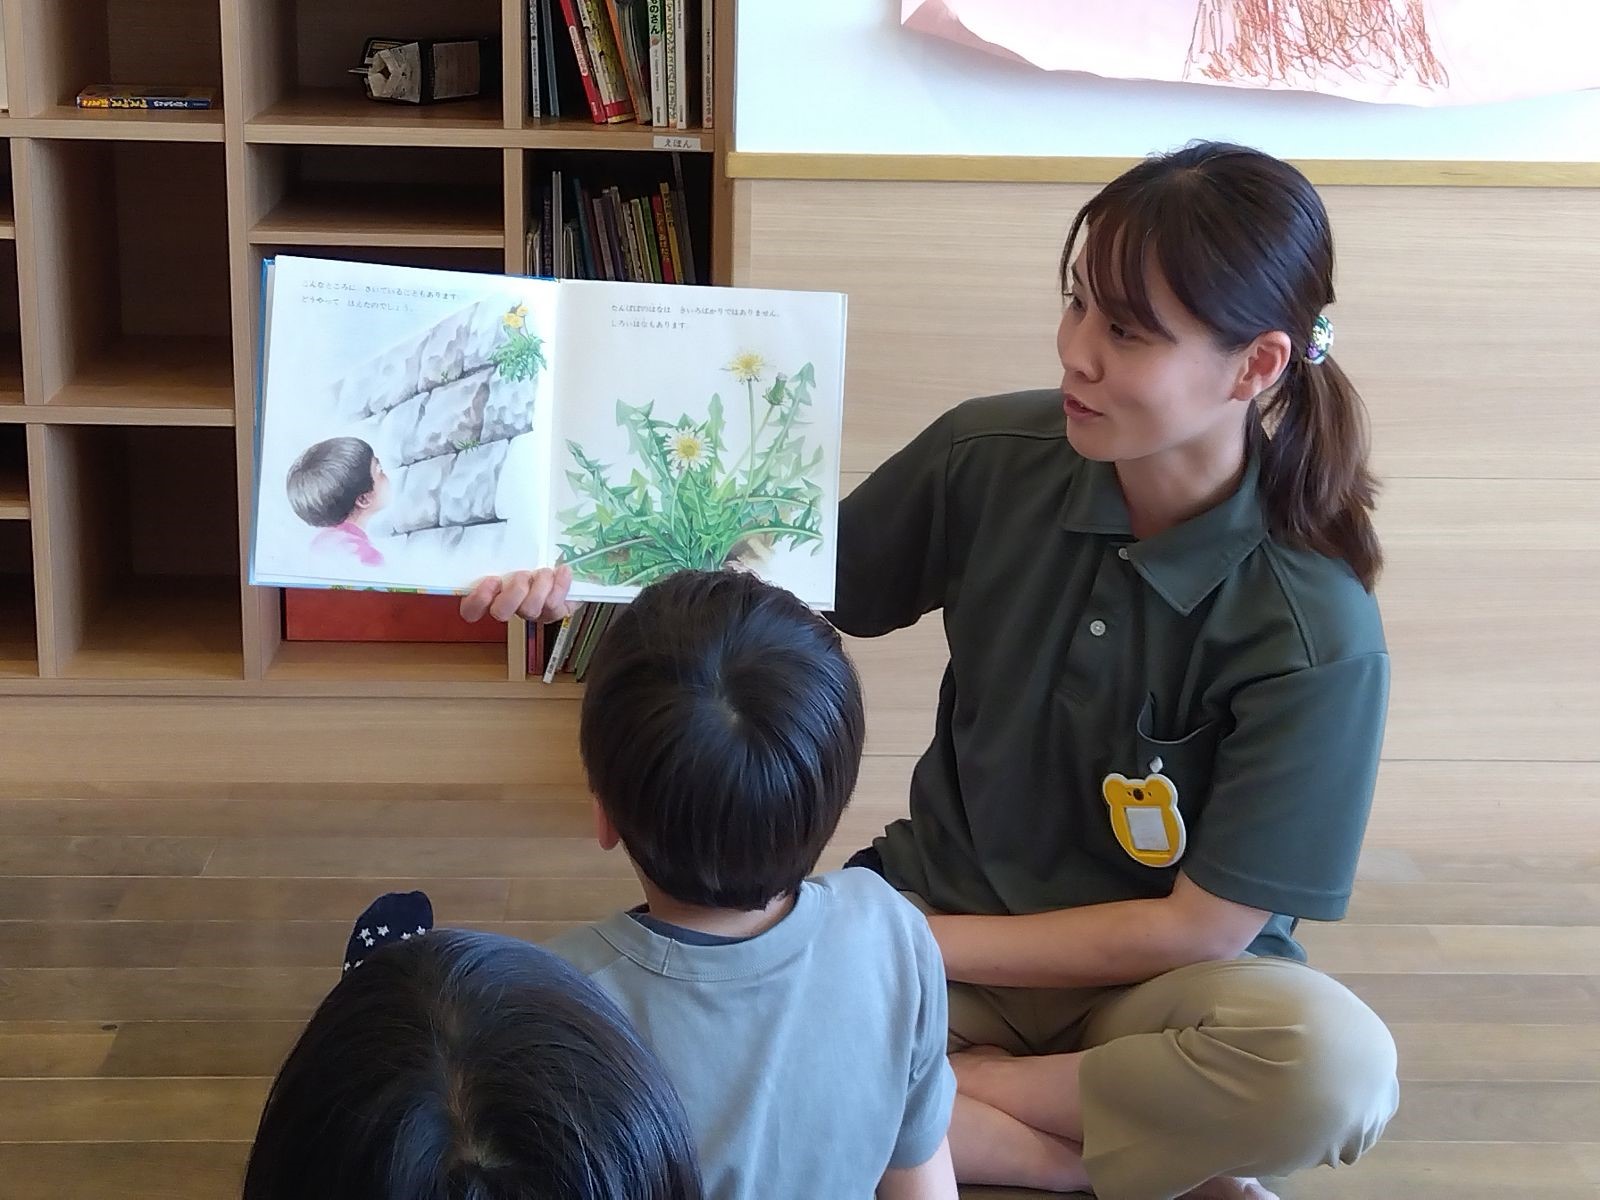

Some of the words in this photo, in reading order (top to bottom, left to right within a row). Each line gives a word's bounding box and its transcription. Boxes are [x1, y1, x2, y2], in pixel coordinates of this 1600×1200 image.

[664, 138, 692, 149] えほん
[302, 295, 339, 306] どうやって
